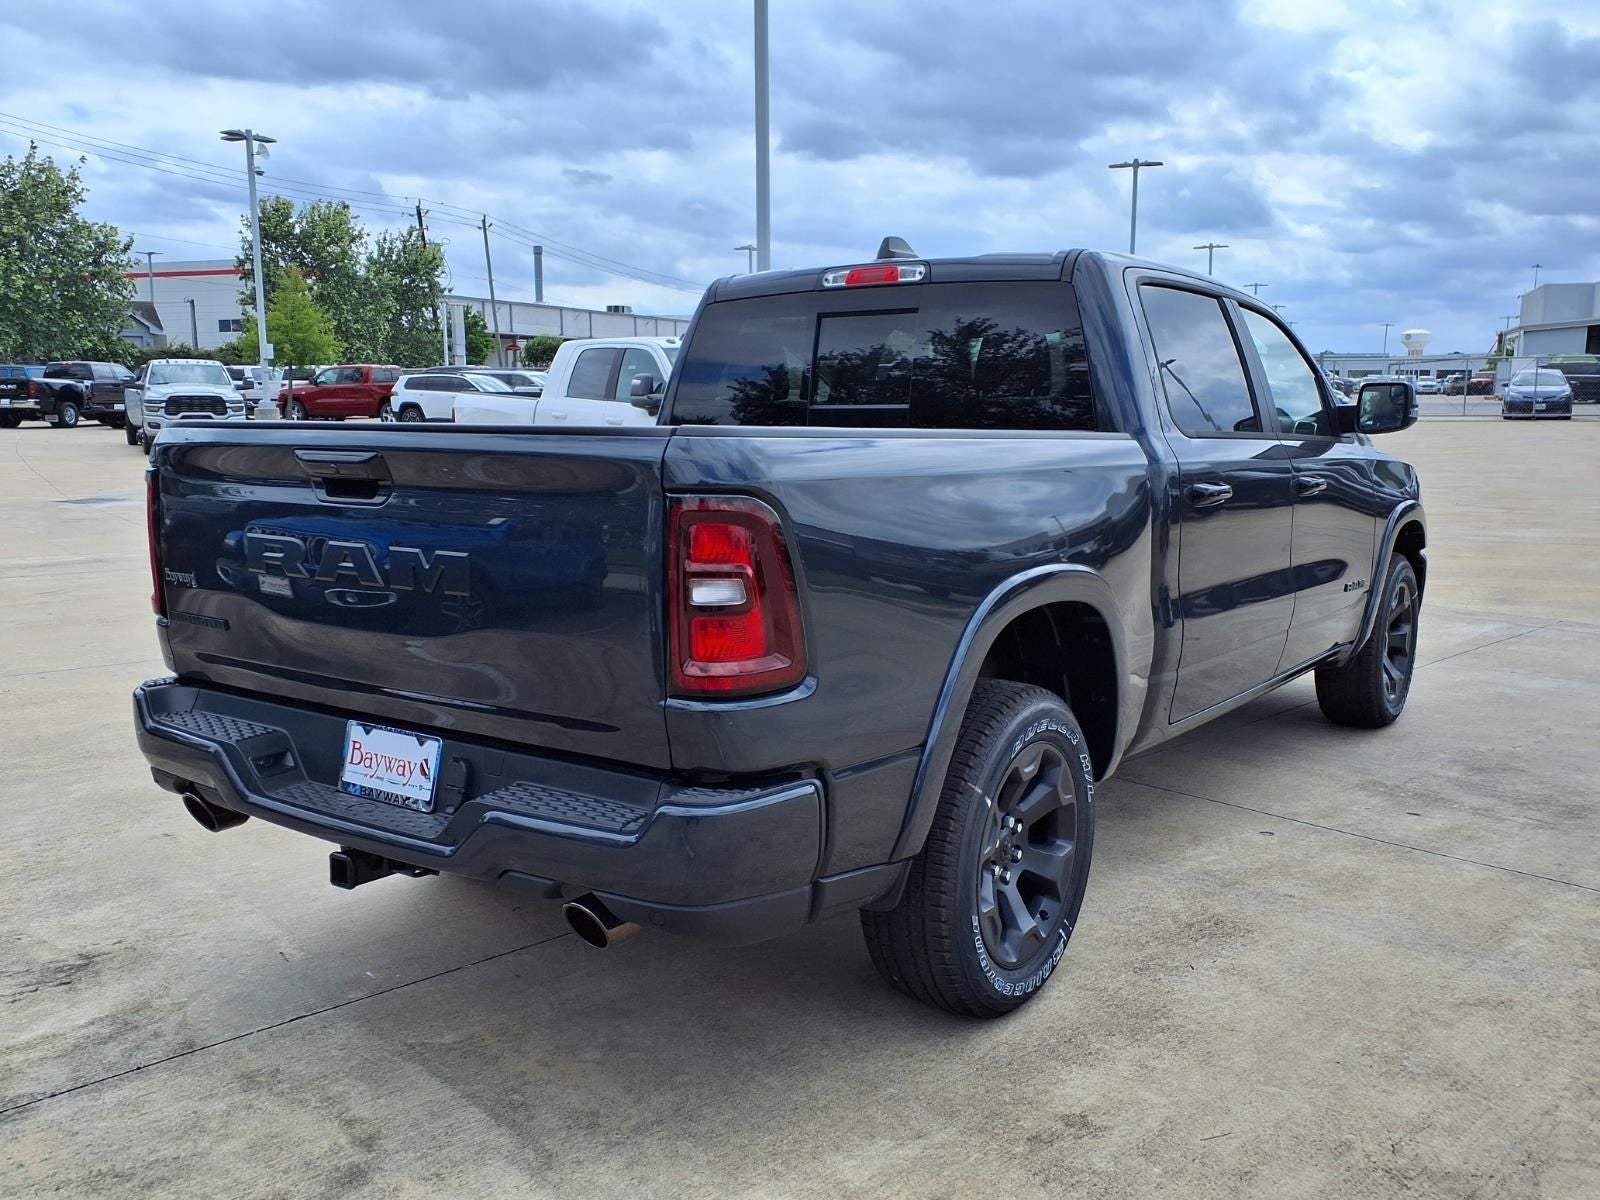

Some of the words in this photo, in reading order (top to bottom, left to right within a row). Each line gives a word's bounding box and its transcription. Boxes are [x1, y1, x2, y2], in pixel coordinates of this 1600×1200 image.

[246, 532, 470, 596] RAM
[348, 740, 417, 787] Bayway
[359, 786, 408, 806] BAYWAY
